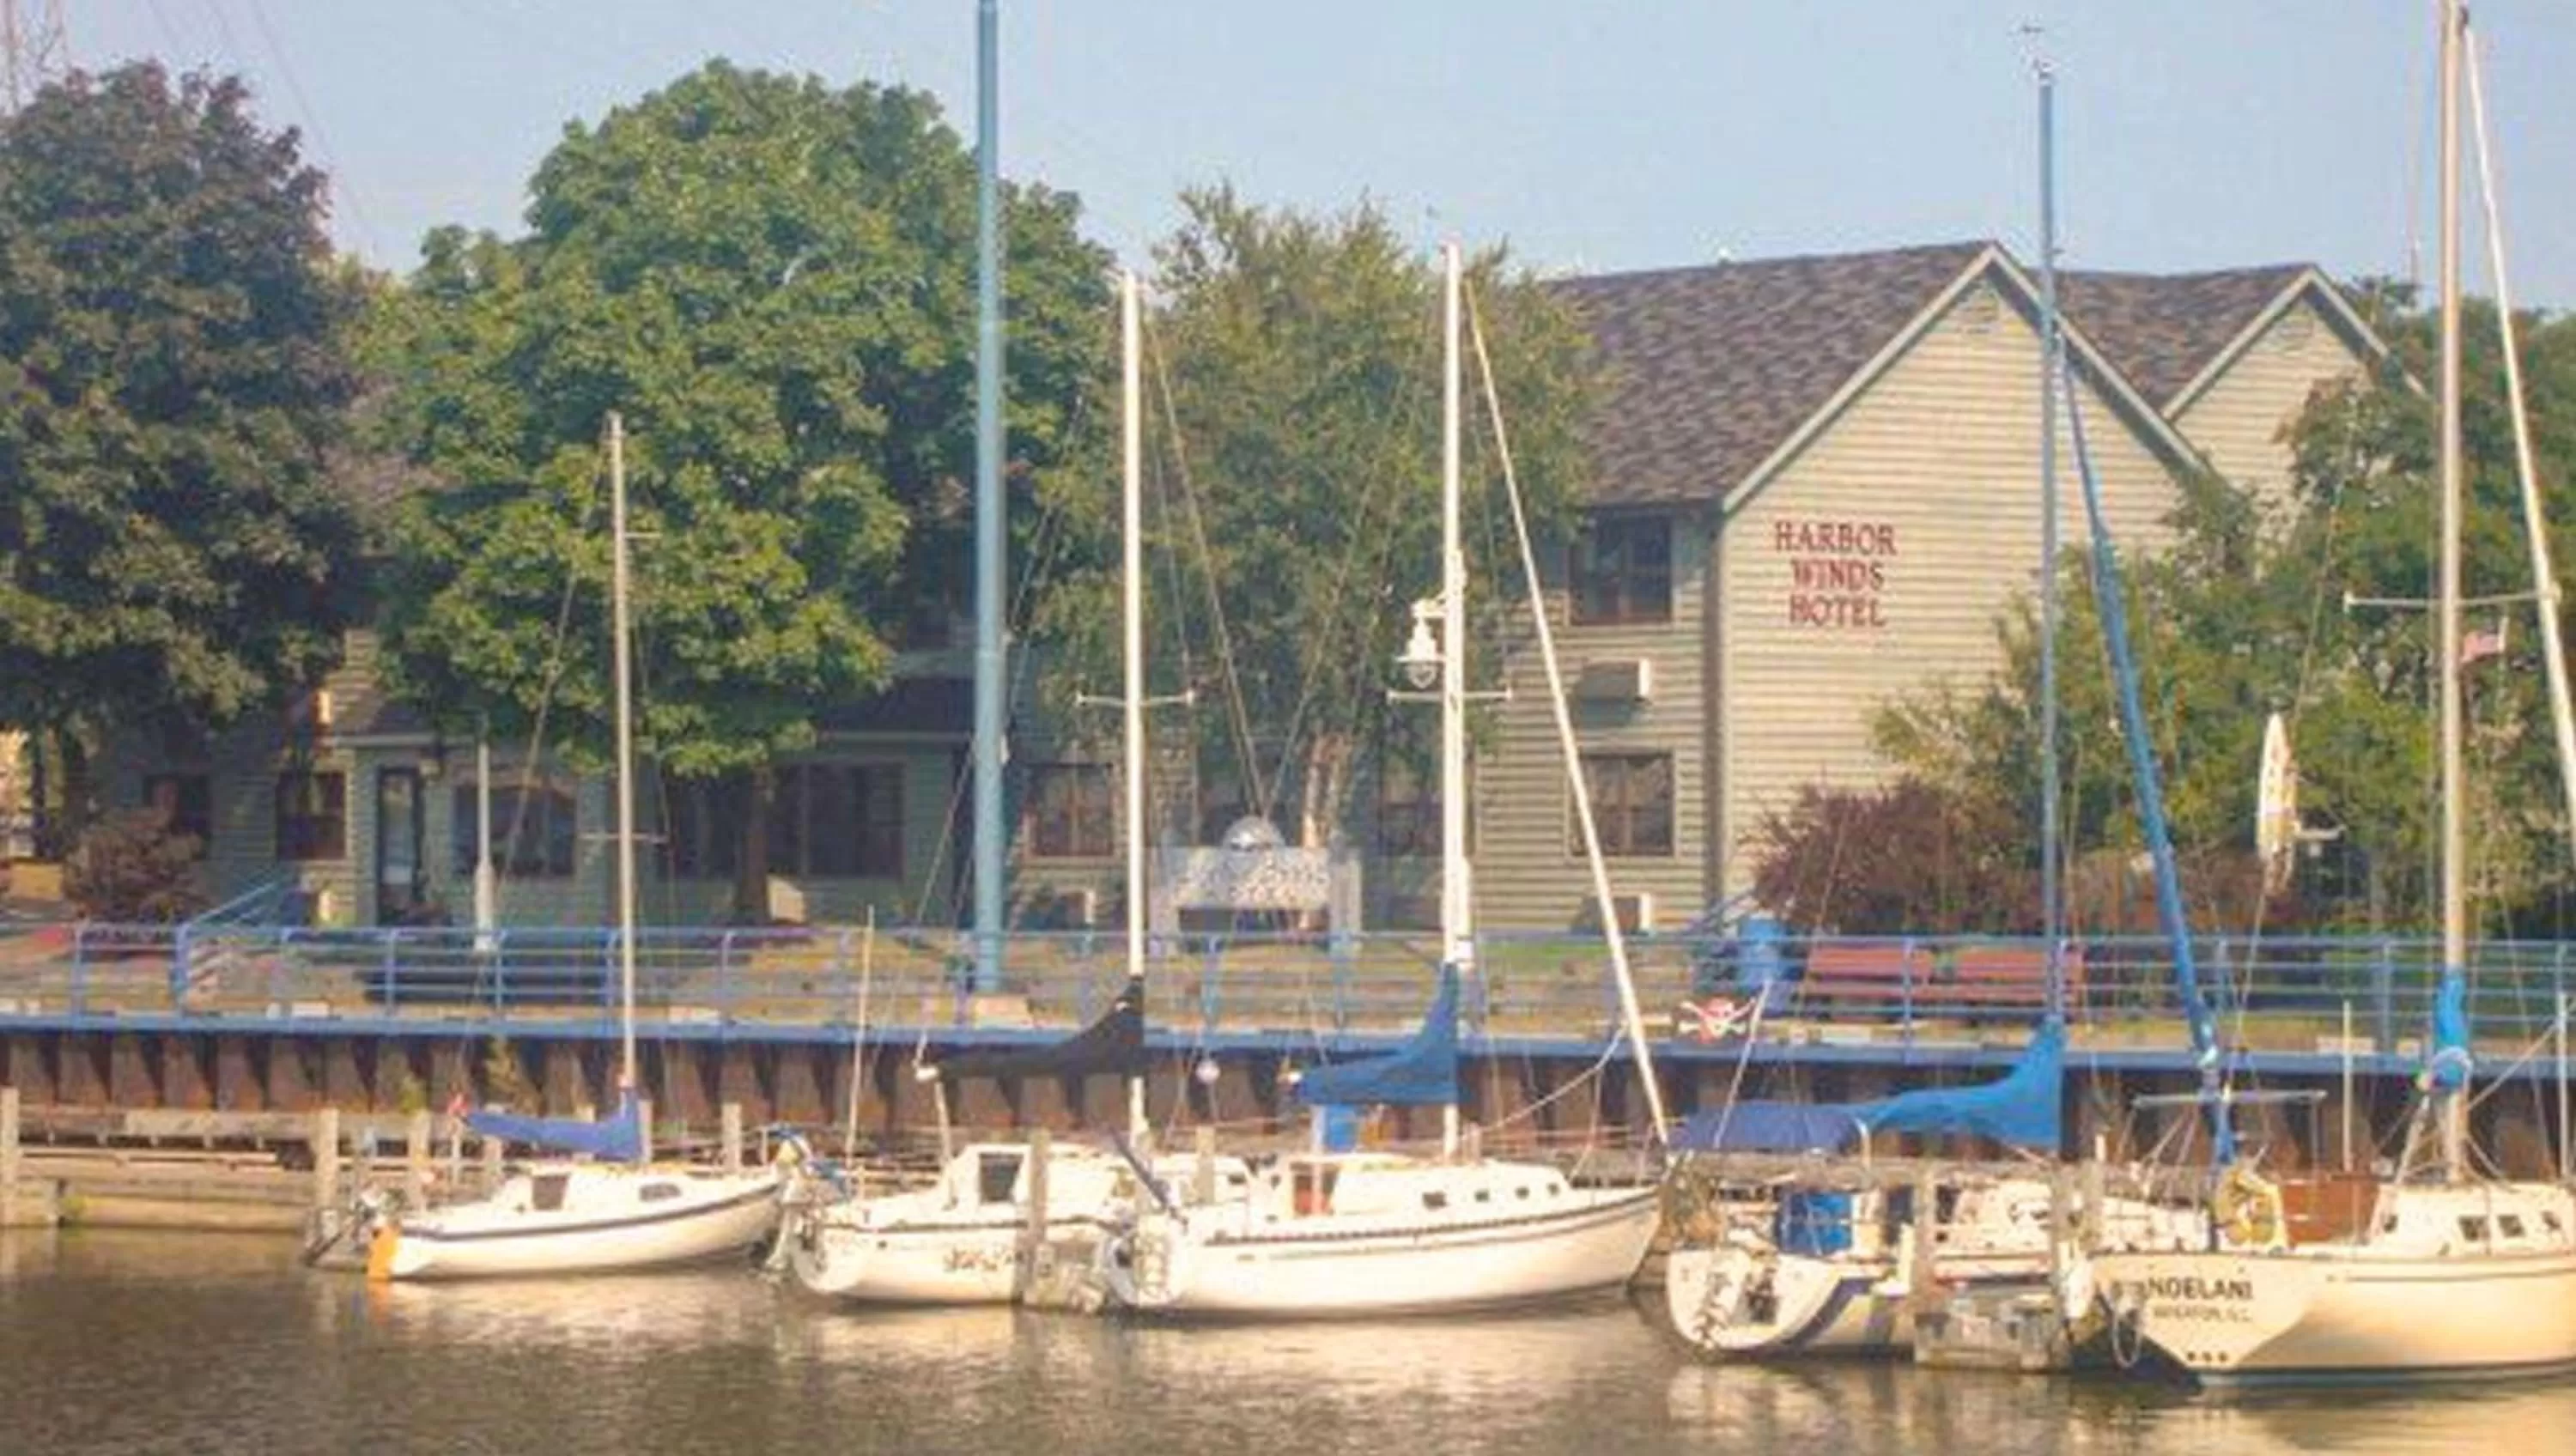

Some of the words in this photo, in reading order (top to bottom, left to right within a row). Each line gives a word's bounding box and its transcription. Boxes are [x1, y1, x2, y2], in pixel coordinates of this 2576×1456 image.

[1775, 521, 1898, 556] HARBOR
[1790, 559, 1885, 592] WINDS
[1789, 593, 1887, 627] HOTEL
